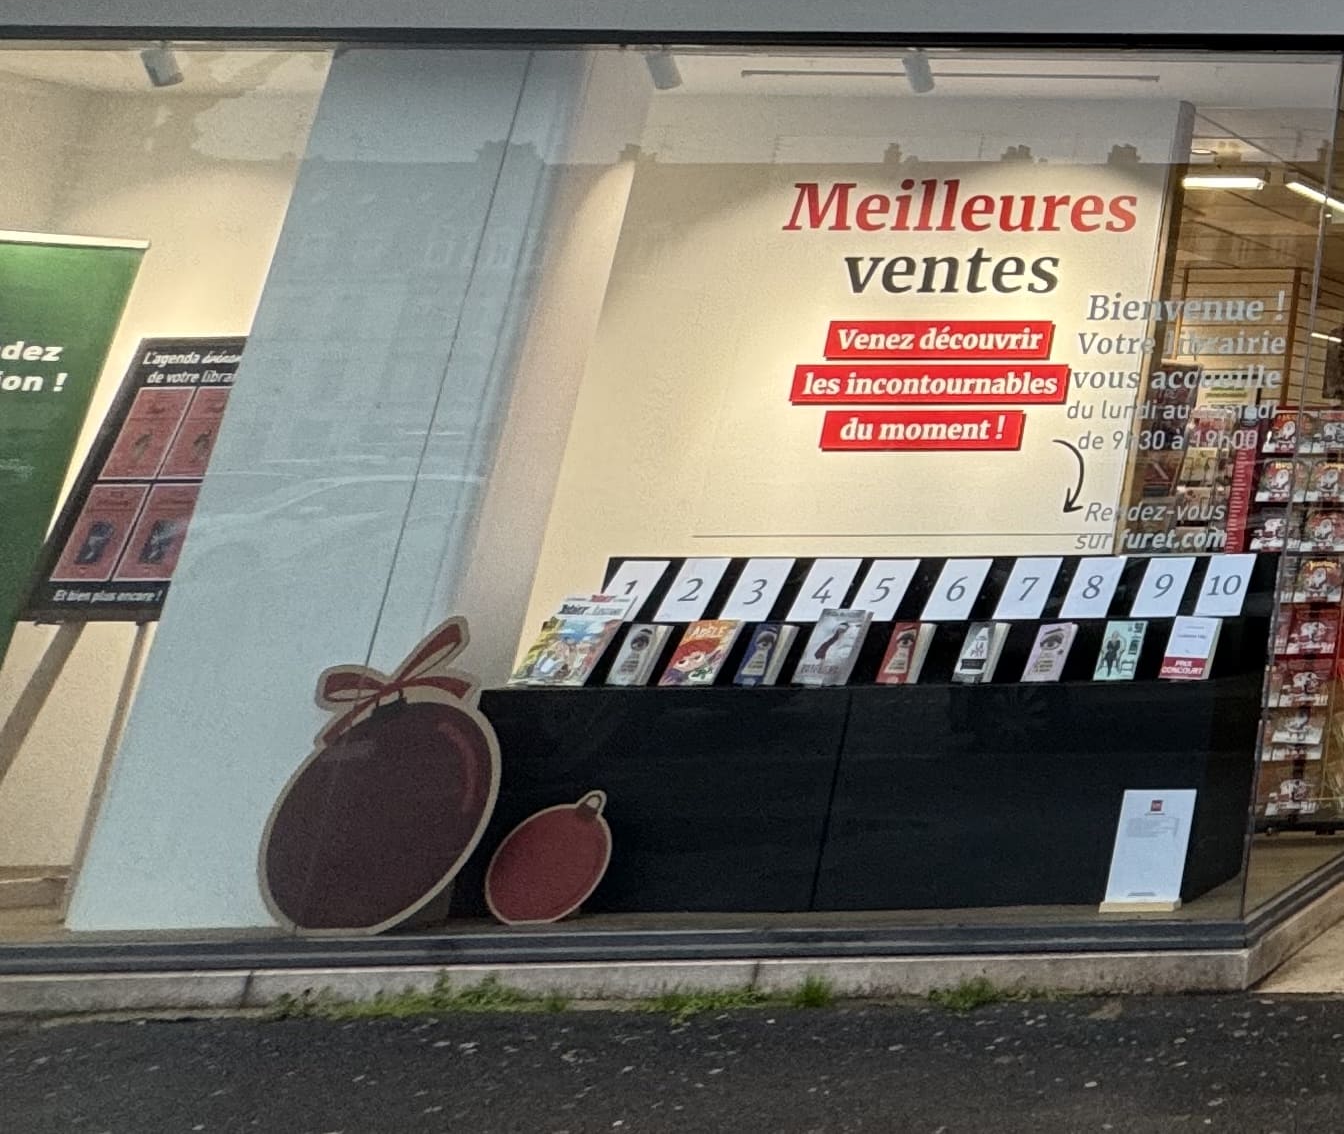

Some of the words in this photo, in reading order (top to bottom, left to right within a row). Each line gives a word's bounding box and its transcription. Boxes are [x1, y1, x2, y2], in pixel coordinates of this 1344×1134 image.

[782, 179, 1138, 232] Meilleures
[844, 247, 1060, 294] ventes
[1087, 293, 1265, 321] Bienvenue
[1275, 290, 1286, 321] !
[838, 328, 914, 351] Venez
[919, 326, 1043, 351] découvrir
[1079, 332, 1156, 355] Votre
[1163, 329, 1287, 356] librairie
[0, 340, 64, 362] dez
[142, 351, 201, 368] L'agenda
[146, 371, 165, 384] de
[166, 371, 200, 383] votre
[802, 372, 840, 396] les
[844, 372, 1058, 396] incontournables
[1073, 370, 1140, 389] vous
[1151, 364, 1282, 390] accueille
[1066, 400, 1093, 419] du
[1102, 399, 1156, 420] lundi
[1163, 404, 1190, 420] au
[840, 418, 873, 441] du
[878, 420, 990, 441] moment
[995, 415, 1006, 441] !
[1078, 431, 1104, 450] de
[1170, 429, 1185, 449] à
[1192, 429, 1259, 450] 19h00
[1075, 533, 1109, 550] sur
[1118, 528, 1227, 549] furet.com
[622, 580, 638, 595] 1
[677, 578, 704, 601] 2
[743, 579, 768, 605] 3
[811, 576, 835, 603] 4
[870, 577, 896, 602] 5
[946, 576, 969, 602] 6
[1018, 577, 1041, 601] 7
[1082, 575, 1104, 599] 8
[1154, 573, 1175, 598] 9
[1206, 574, 1242, 597] 10
